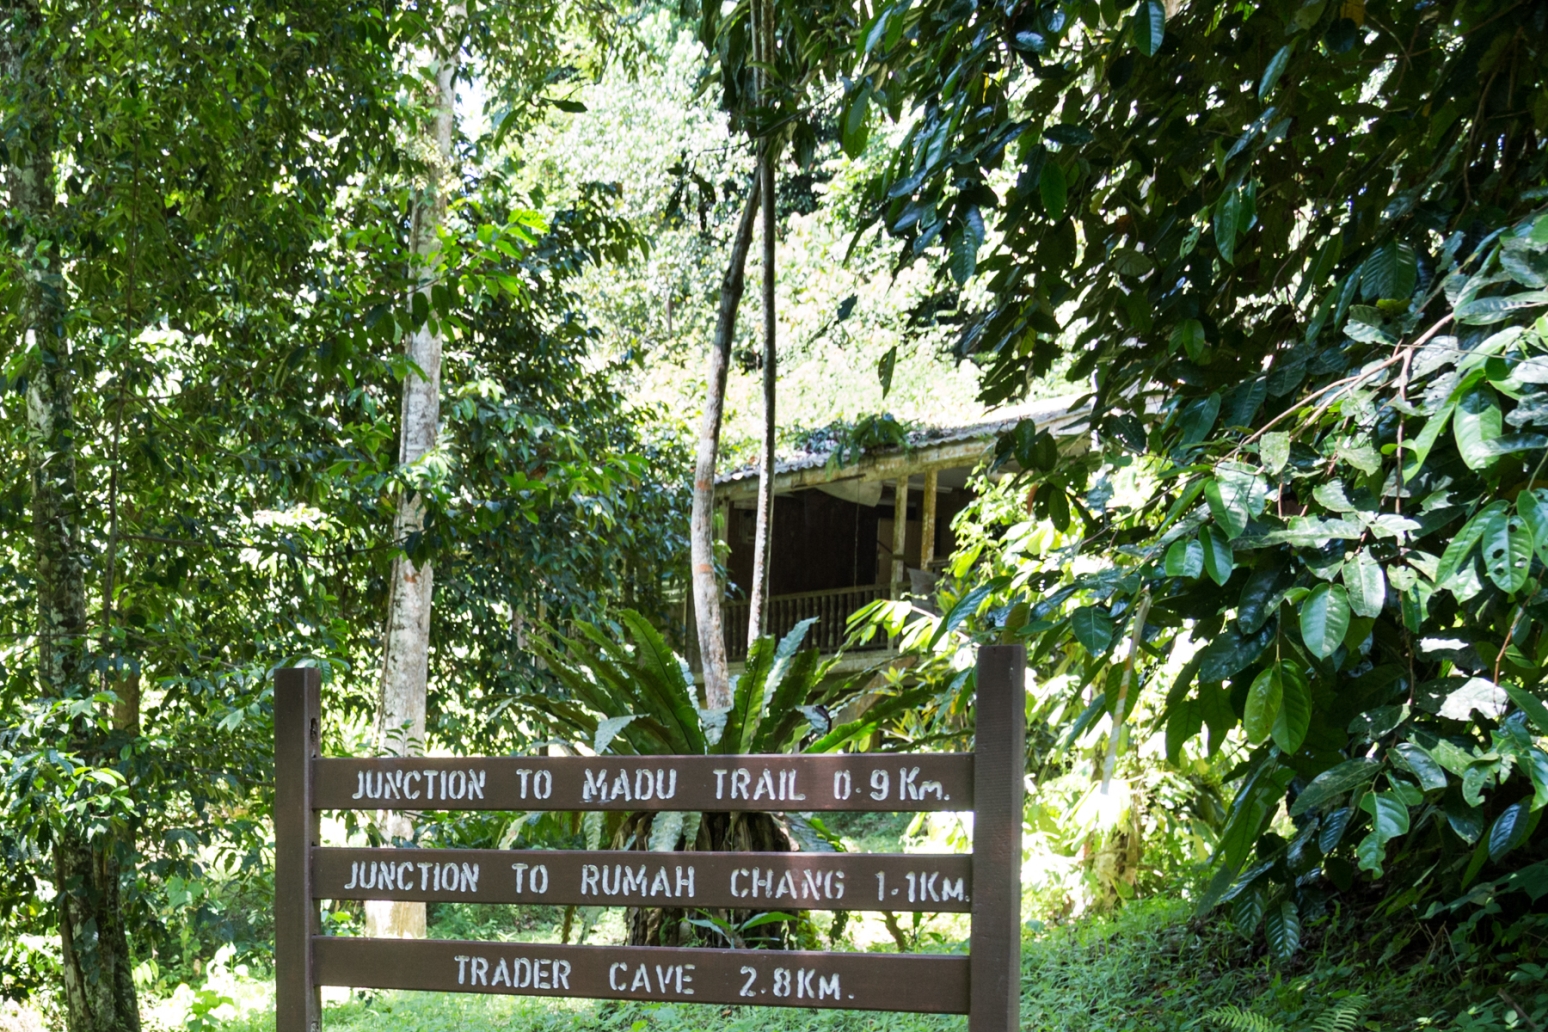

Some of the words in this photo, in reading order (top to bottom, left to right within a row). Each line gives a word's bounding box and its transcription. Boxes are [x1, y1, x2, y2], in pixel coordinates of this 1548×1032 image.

[352, 769, 486, 801] JUNCTION
[516, 768, 552, 799] TO
[582, 768, 677, 801] MADU
[713, 768, 806, 800] TRAIL
[344, 860, 479, 892] JUNCTION
[511, 863, 548, 893] TO
[581, 864, 695, 898] RUMAH
[730, 866, 845, 900] CHANG
[454, 955, 571, 989] TRADER
[609, 962, 696, 994] CAVE
